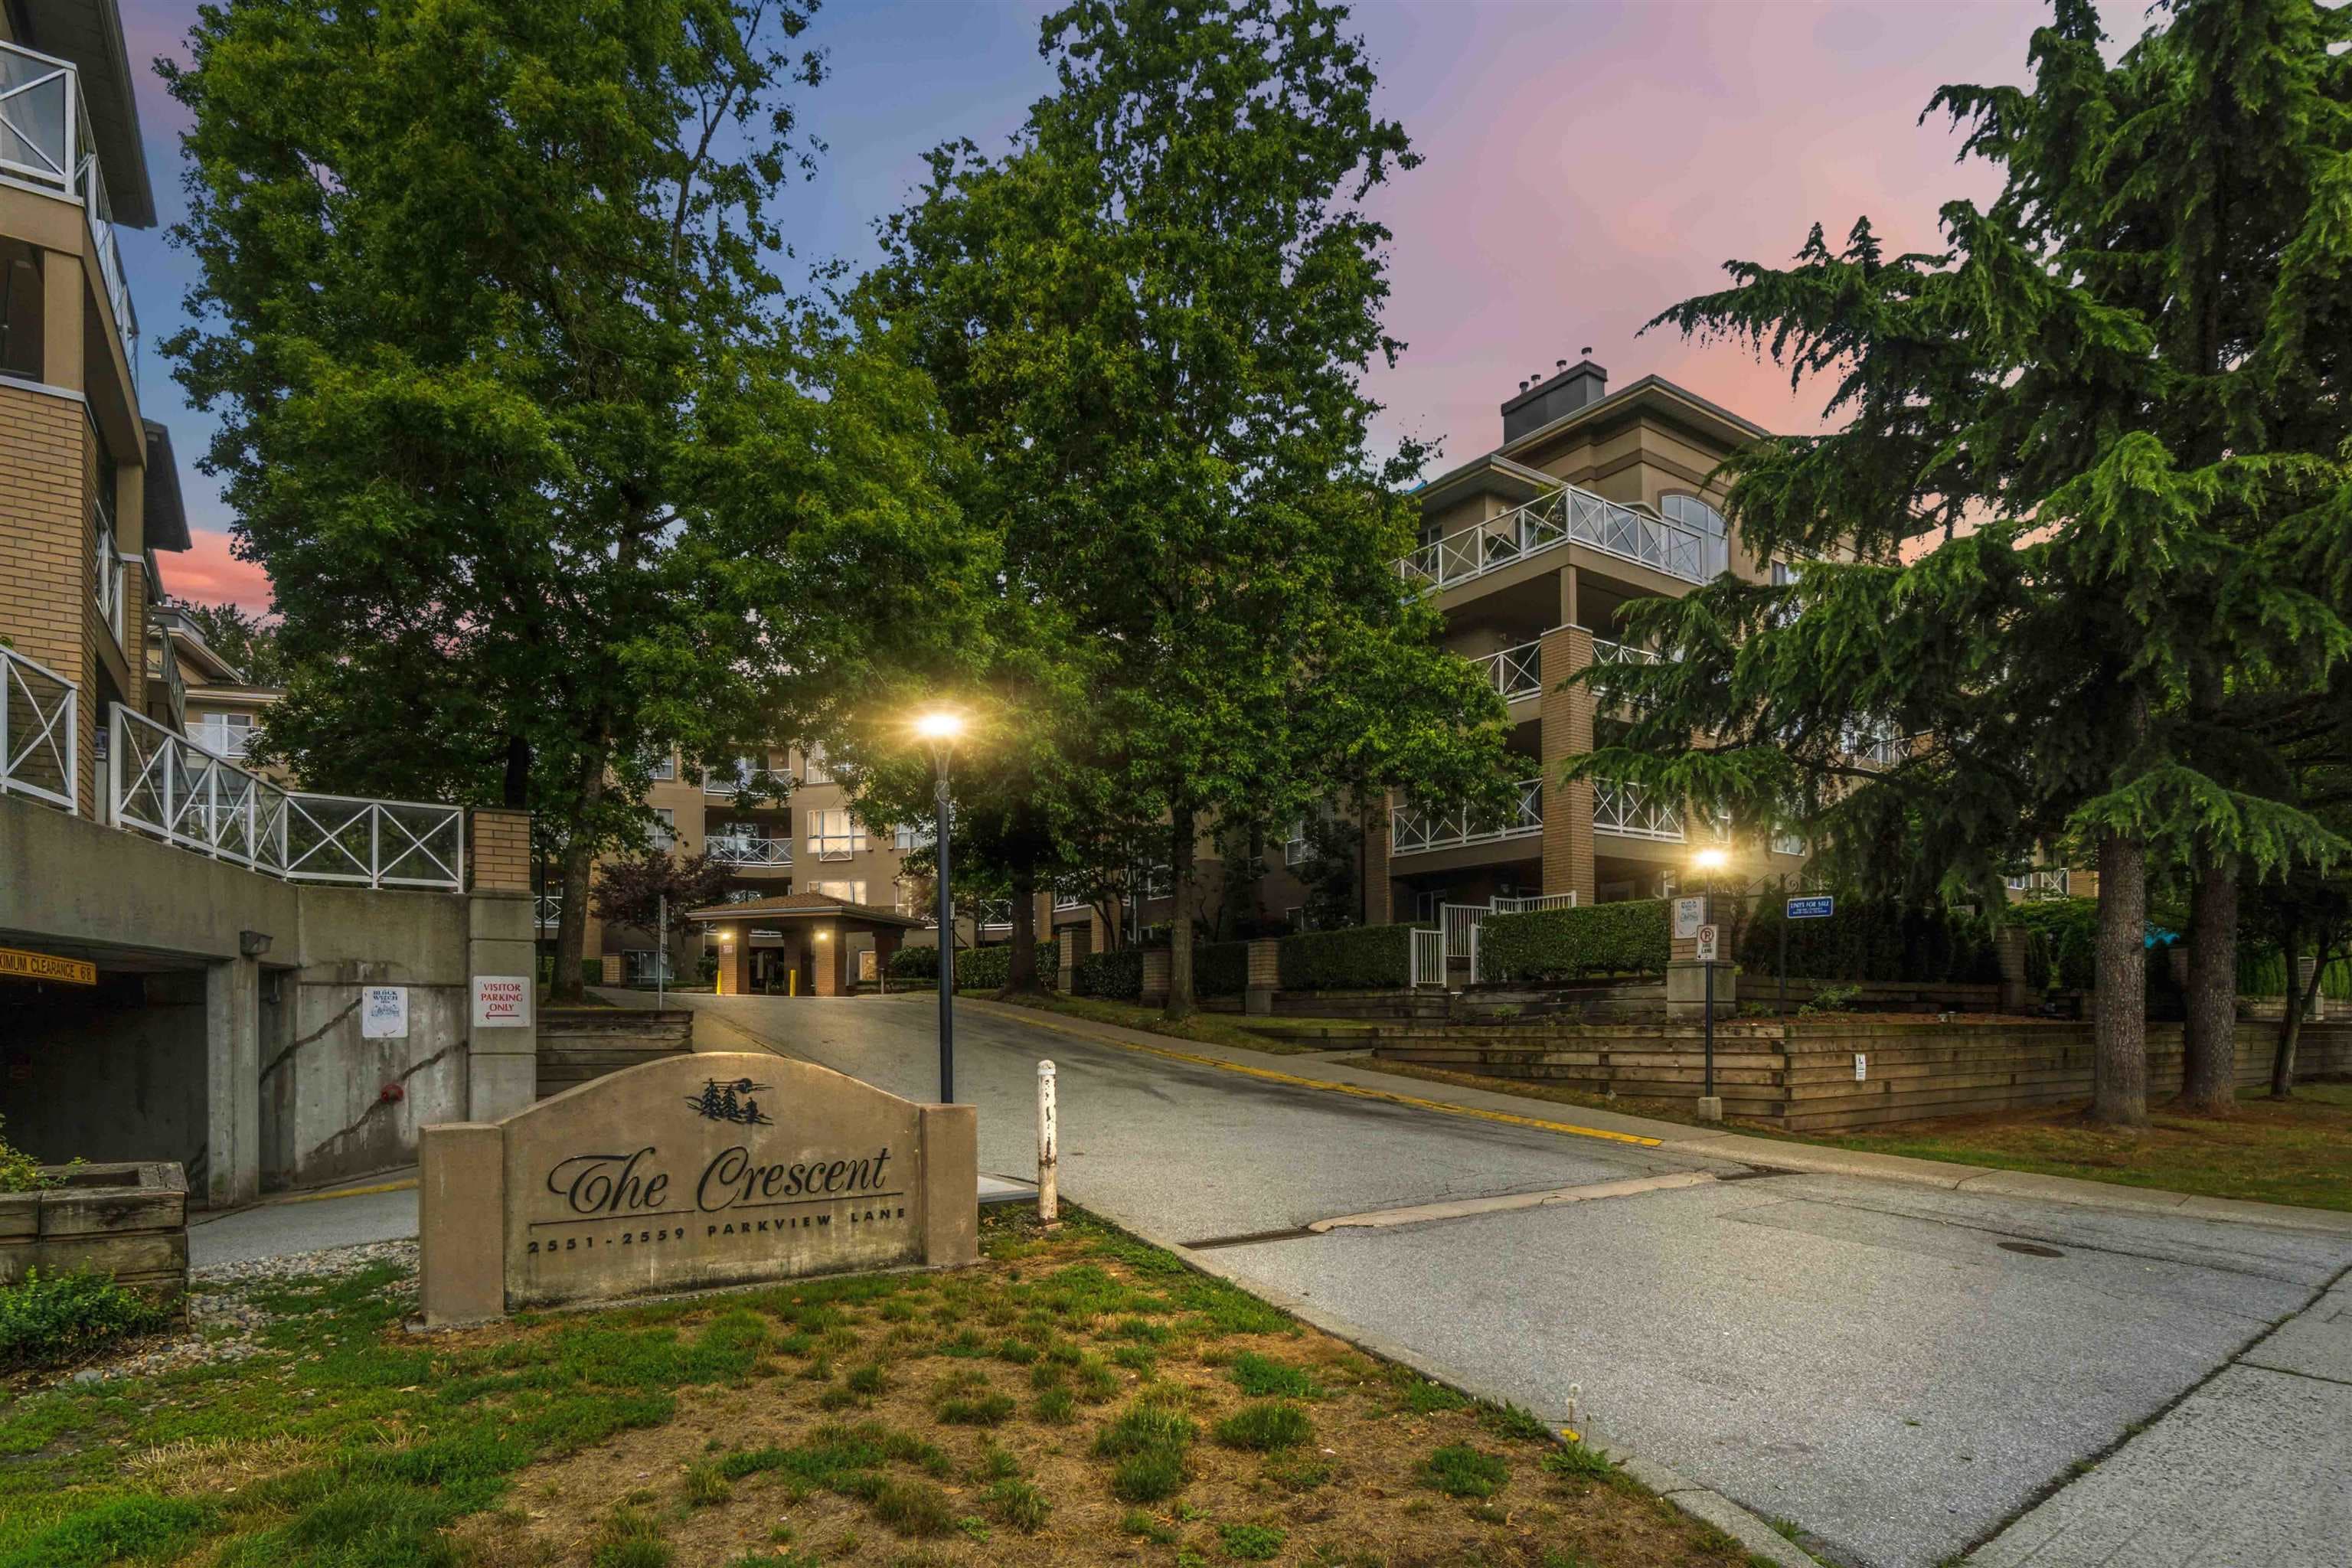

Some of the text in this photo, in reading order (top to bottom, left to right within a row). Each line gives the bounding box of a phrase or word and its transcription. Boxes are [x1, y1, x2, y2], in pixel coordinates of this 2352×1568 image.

[31, 958, 75, 978] CLEARANCE
[483, 983, 521, 991] VISITOR
[481, 993, 523, 1001] PARKING
[489, 1003, 514, 1011] ONLY
[547, 1145, 892, 1214] The Crescent
[707, 1214, 832, 1237] PARKVIEW
[851, 1207, 906, 1223] LANE
